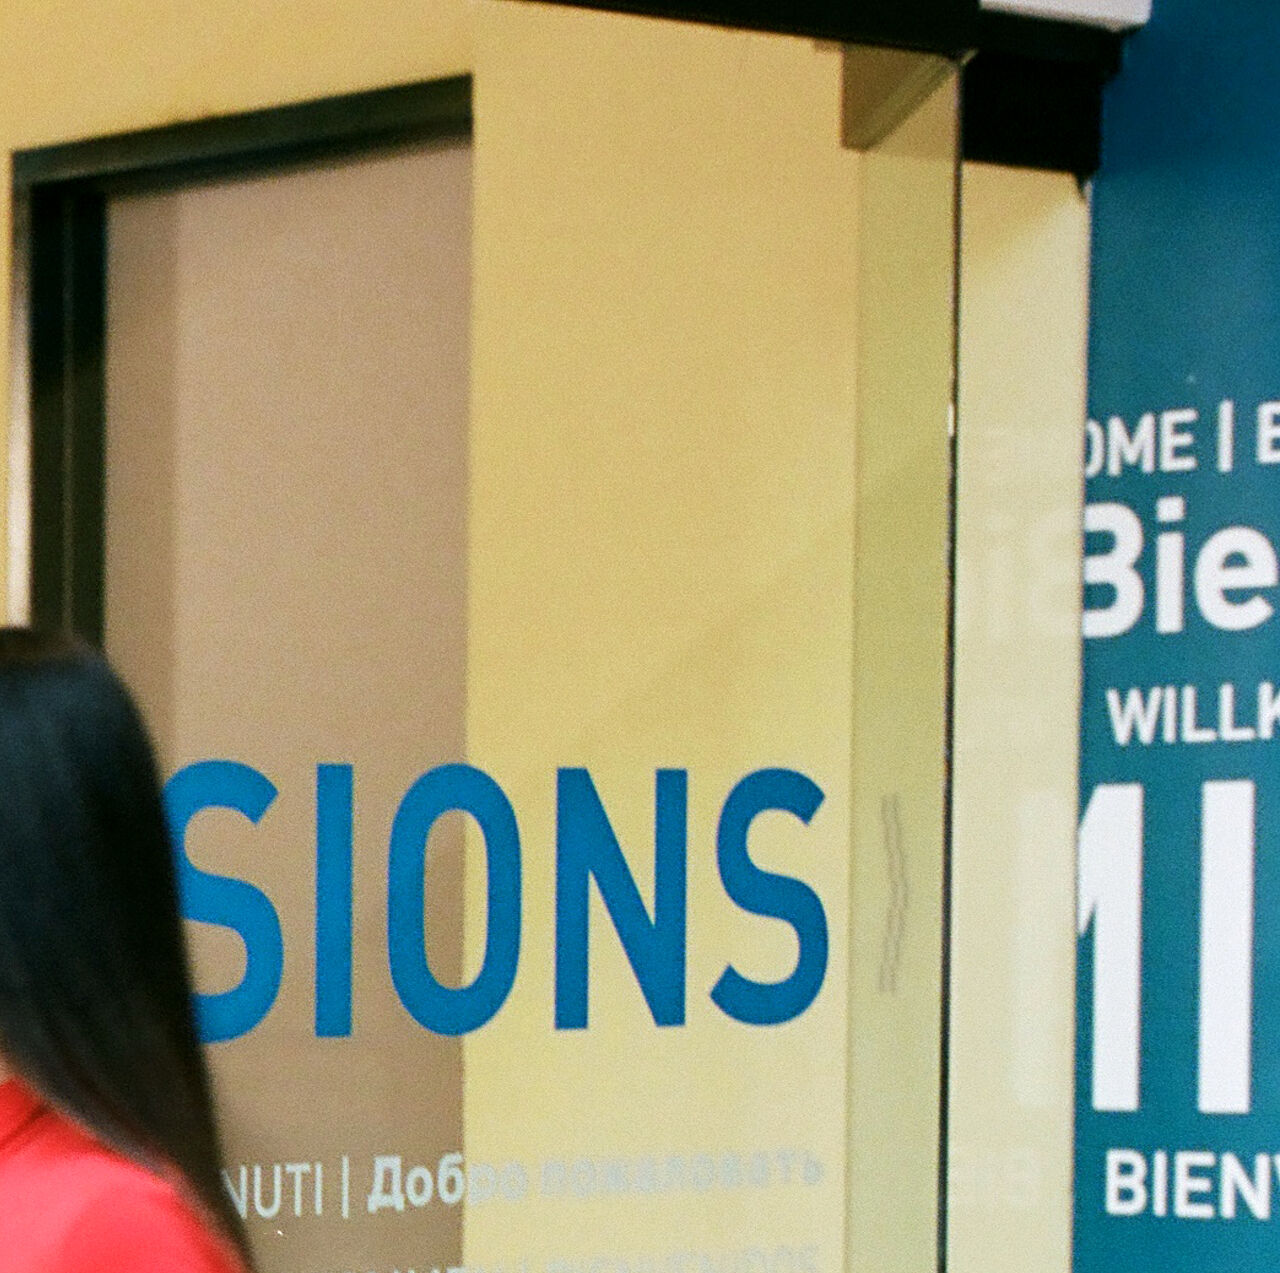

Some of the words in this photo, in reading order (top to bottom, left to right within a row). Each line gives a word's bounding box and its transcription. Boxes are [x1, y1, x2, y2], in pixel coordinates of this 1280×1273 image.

[1083, 496, 1279, 638] Bie
[1106, 682, 1280, 745] WILLK
[219, 1162, 324, 1220] NUTI
[366, 1152, 529, 1215] Добро
[1105, 1149, 1280, 1220] BIEN
